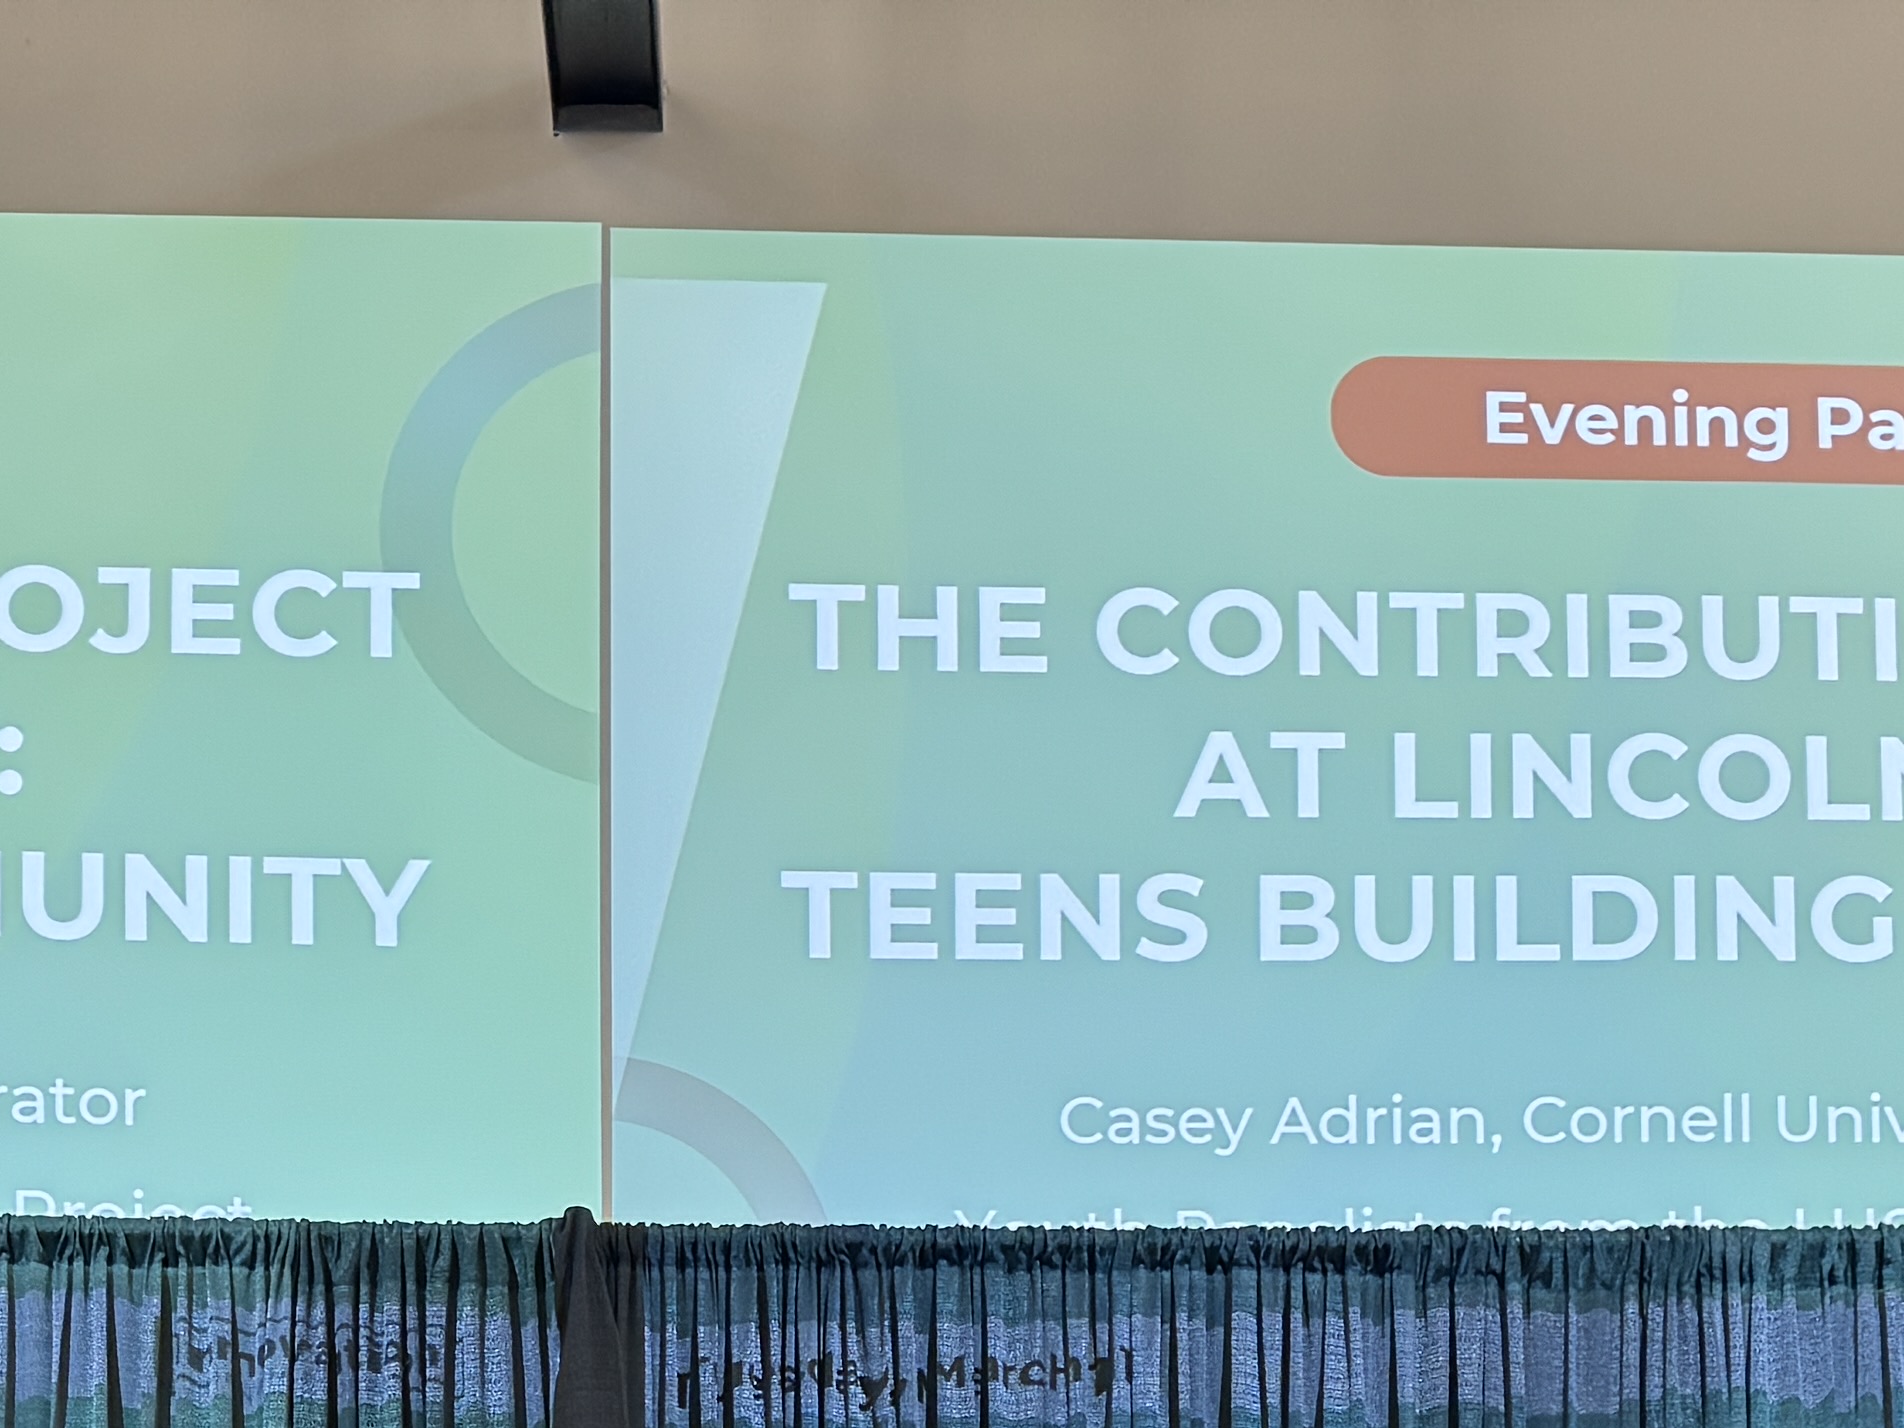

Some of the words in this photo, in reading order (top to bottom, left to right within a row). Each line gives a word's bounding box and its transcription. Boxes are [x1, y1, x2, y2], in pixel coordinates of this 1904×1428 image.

[1486, 389, 1788, 461] Evening
[789, 584, 1047, 672] THE
[1173, 732, 1345, 817] AT
[781, 871, 1207, 961] TEENS
[1260, 875, 1893, 962] BUILDING
[1061, 1097, 1253, 1155] Casey
[1270, 1094, 1501, 1153] Adrian,
[1524, 1093, 1749, 1143] Cornell
